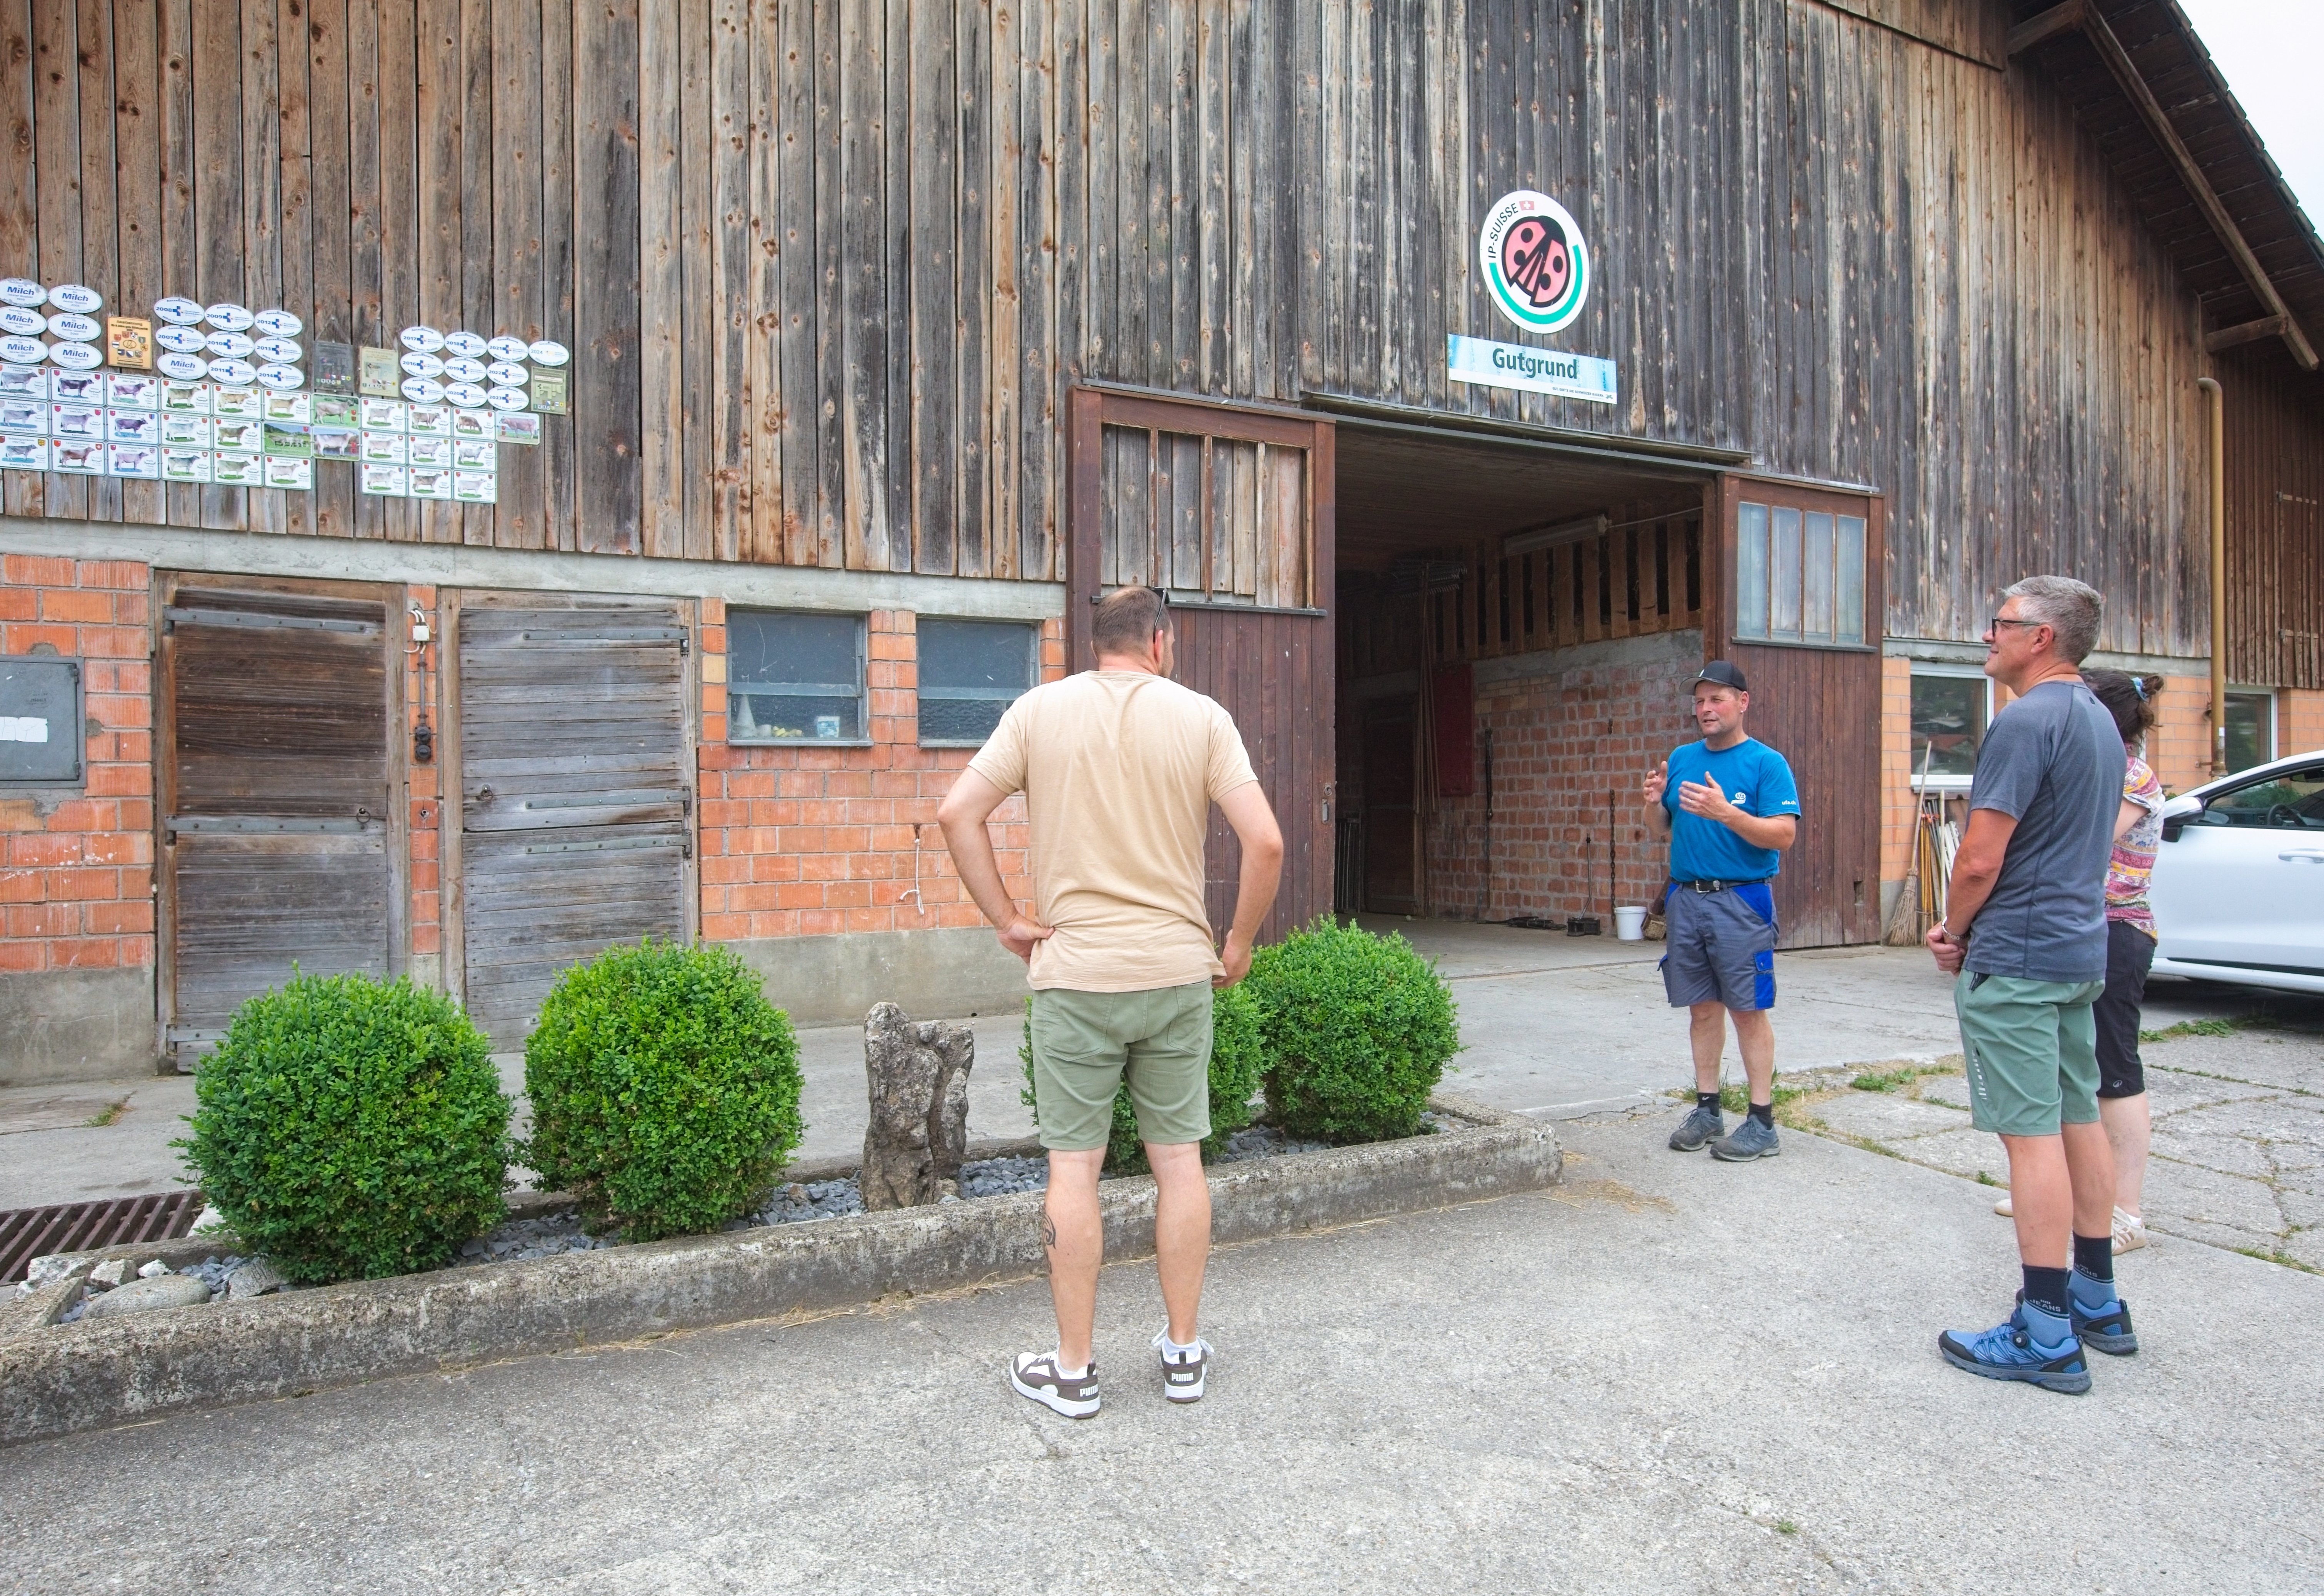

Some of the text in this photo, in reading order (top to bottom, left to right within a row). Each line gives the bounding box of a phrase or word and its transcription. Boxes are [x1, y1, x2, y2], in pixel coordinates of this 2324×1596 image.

[1488, 202, 1518, 258] IP-SUISSE
[7, 286, 35, 295] Milch
[62, 293, 88, 301] Milch
[5, 314, 33, 324] Milch
[61, 321, 88, 329] Milch
[63, 349, 89, 358] Milch
[170, 360, 195, 369] Milch
[1492, 348, 1577, 379] Gutgrund
[2029, 1299, 2061, 1312] JEANS
[1171, 1372, 1194, 1382] PUMA
